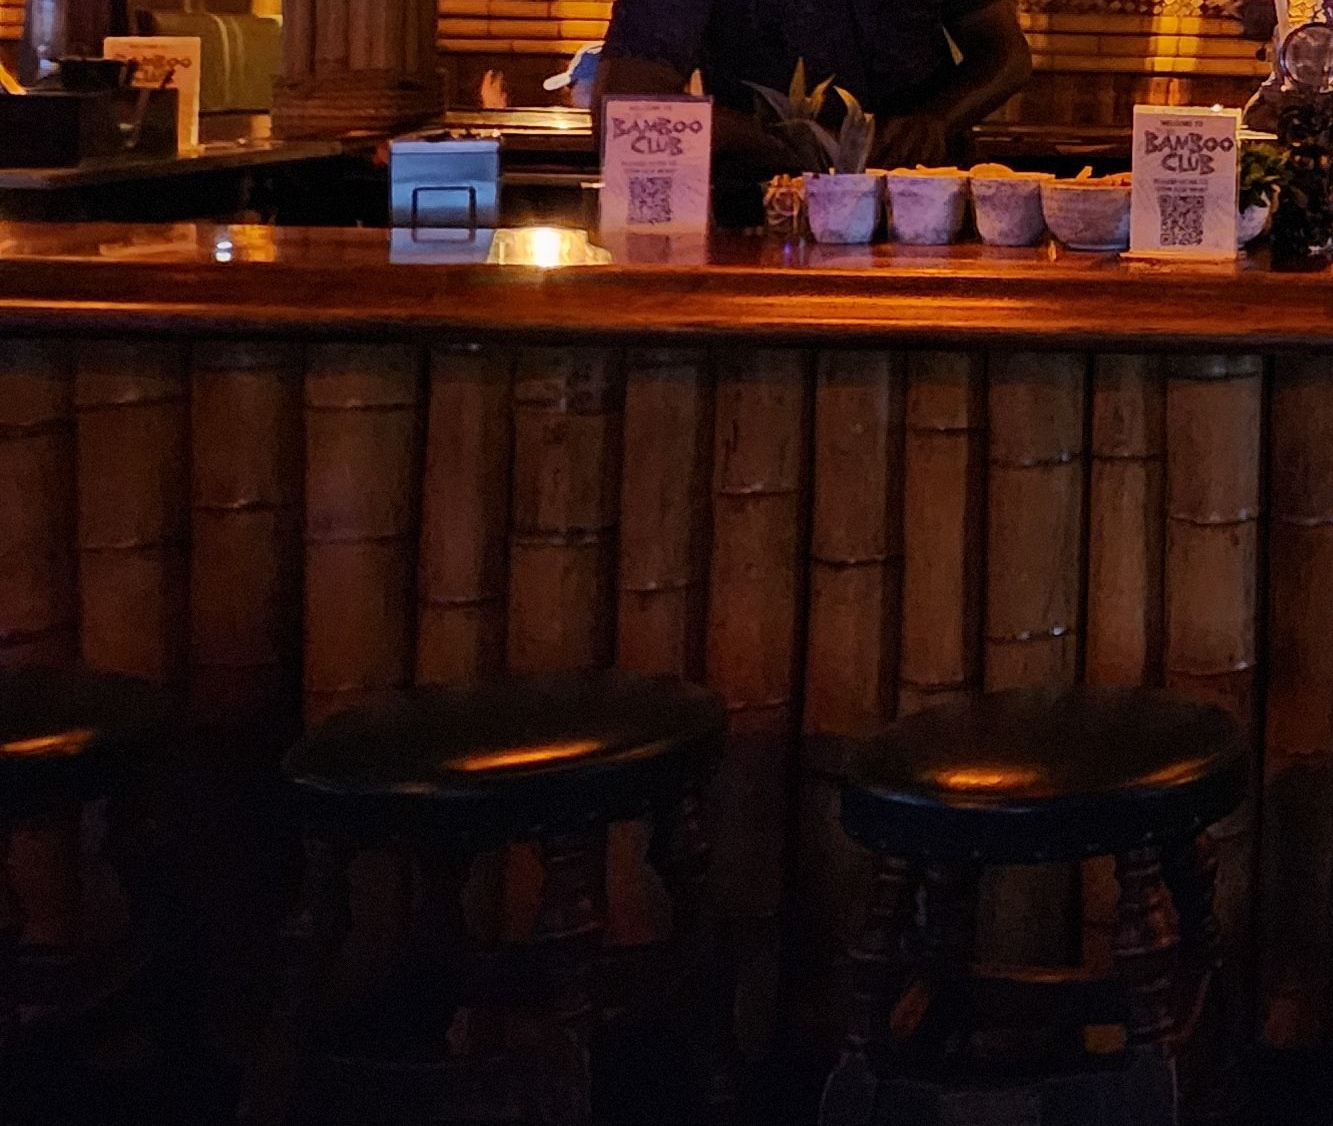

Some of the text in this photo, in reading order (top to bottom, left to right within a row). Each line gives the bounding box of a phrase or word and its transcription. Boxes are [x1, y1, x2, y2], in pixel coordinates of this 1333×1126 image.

[612, 117, 703, 139] BAMBOO
[631, 136, 684, 156] CLUB
[1144, 130, 1234, 155] BAMBOO
[1161, 153, 1215, 175] CLUB
